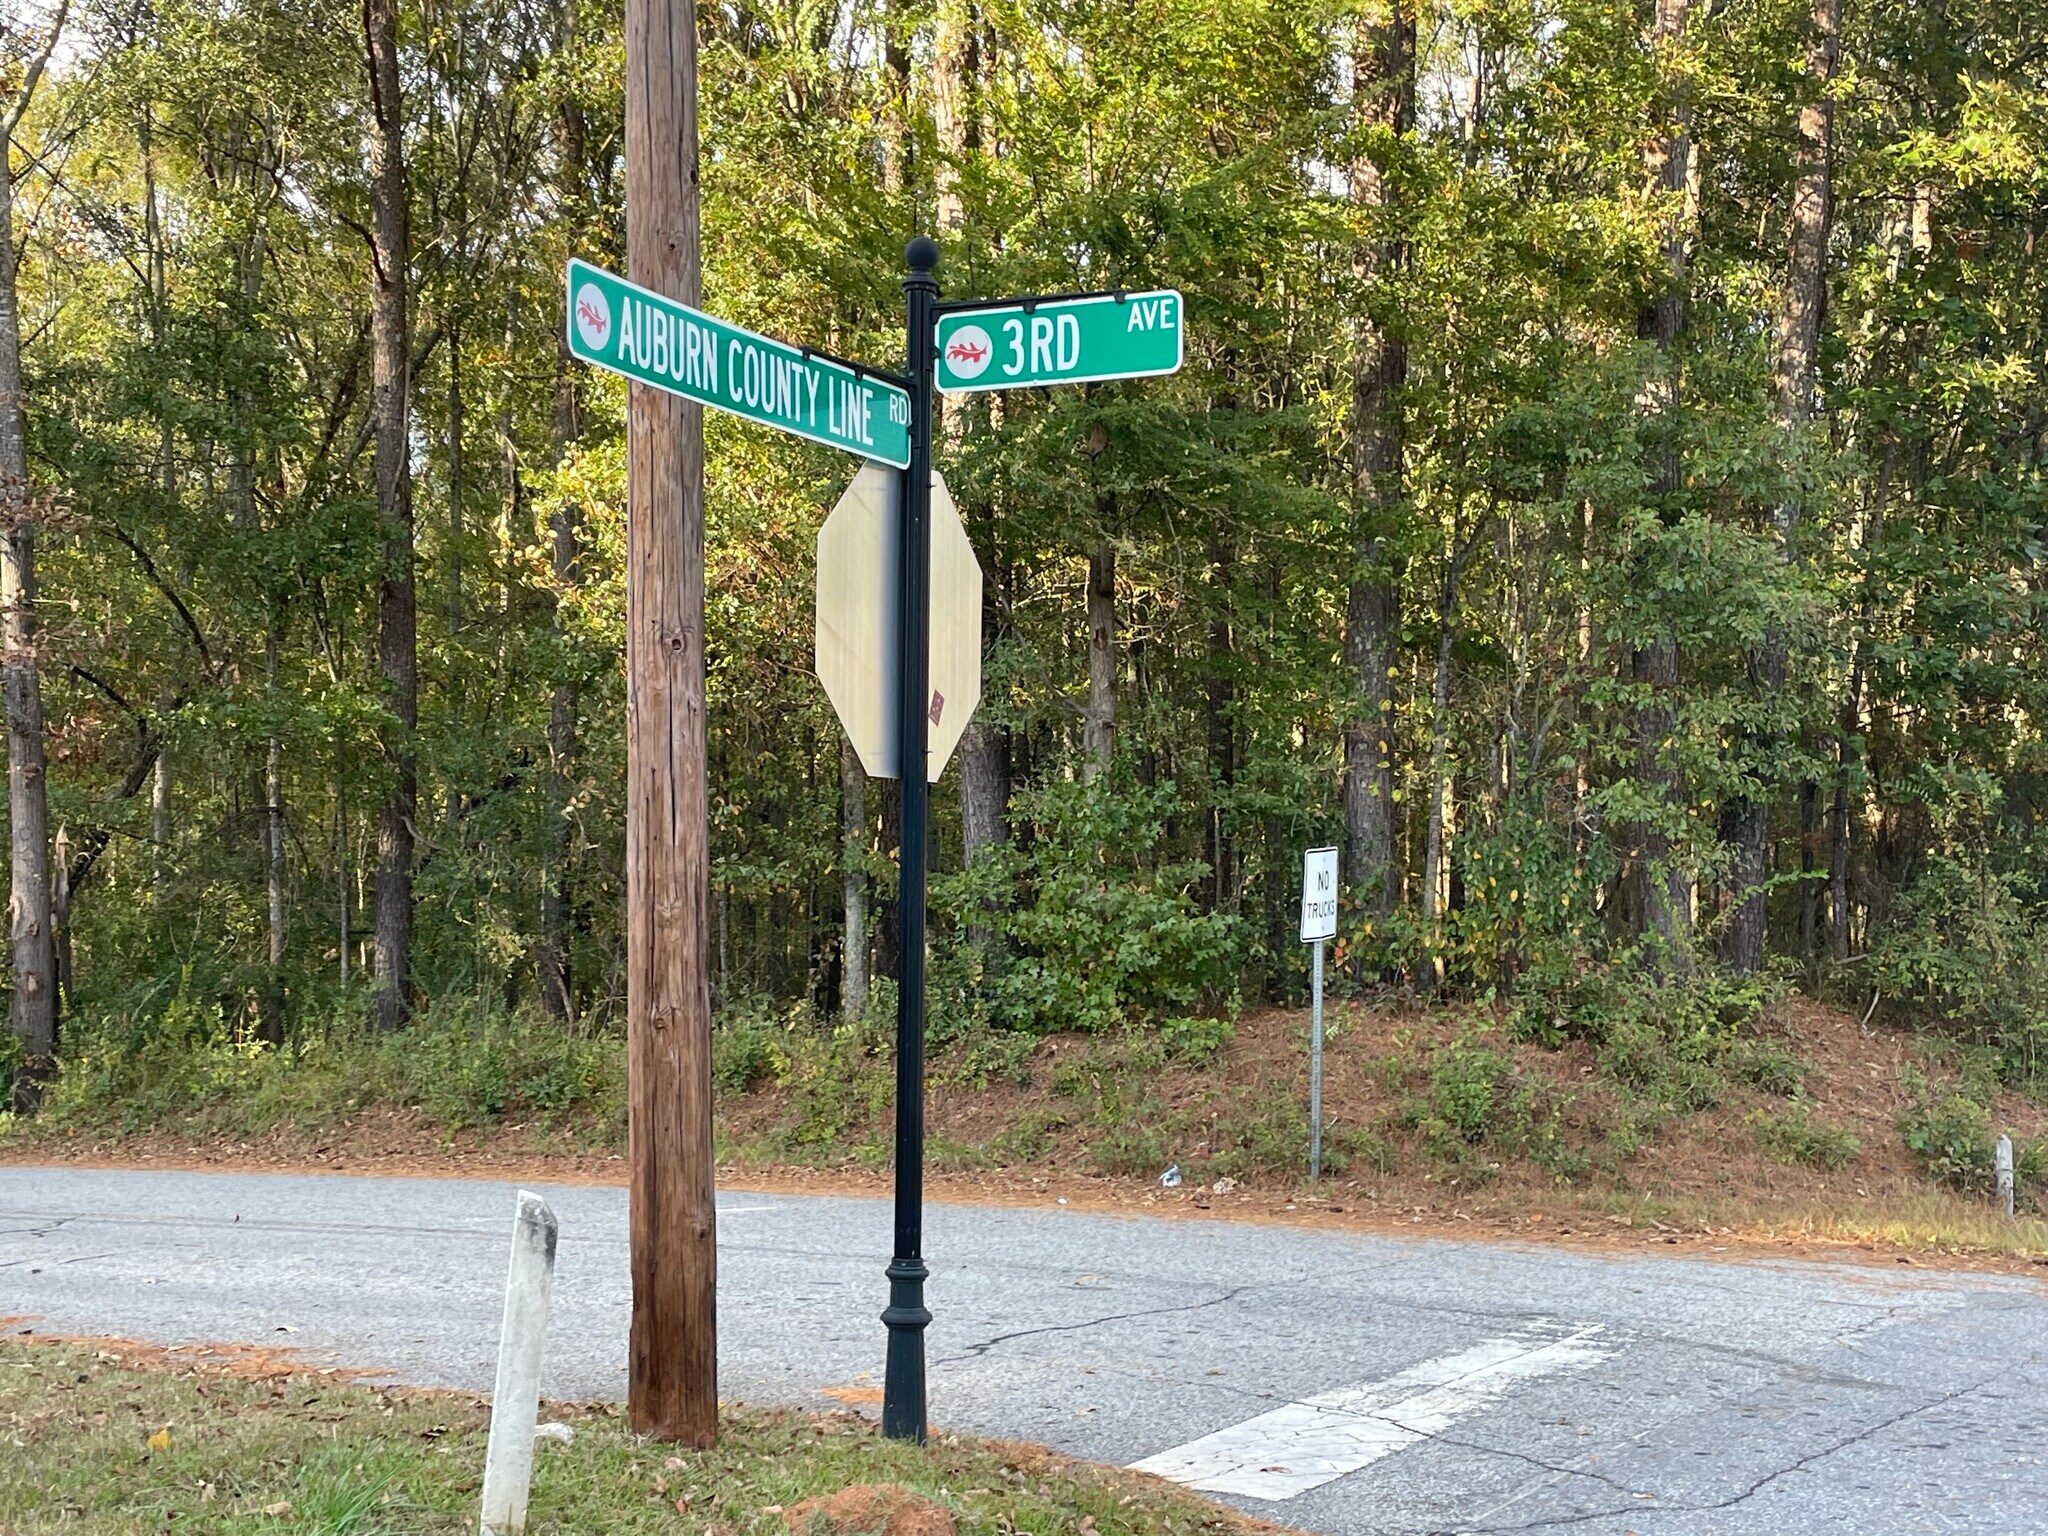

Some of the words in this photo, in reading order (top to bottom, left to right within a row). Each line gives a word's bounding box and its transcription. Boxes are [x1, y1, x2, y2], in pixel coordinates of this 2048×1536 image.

[1002, 313, 1080, 376] 3RD
[1127, 299, 1175, 333] AVE
[618, 296, 718, 394] AUBURN
[728, 338, 820, 427] COUNTY
[828, 375, 874, 446] LINE
[889, 395, 908, 425] RD
[1318, 870, 1330, 891] NO
[1307, 900, 1335, 919] TRUCKS
